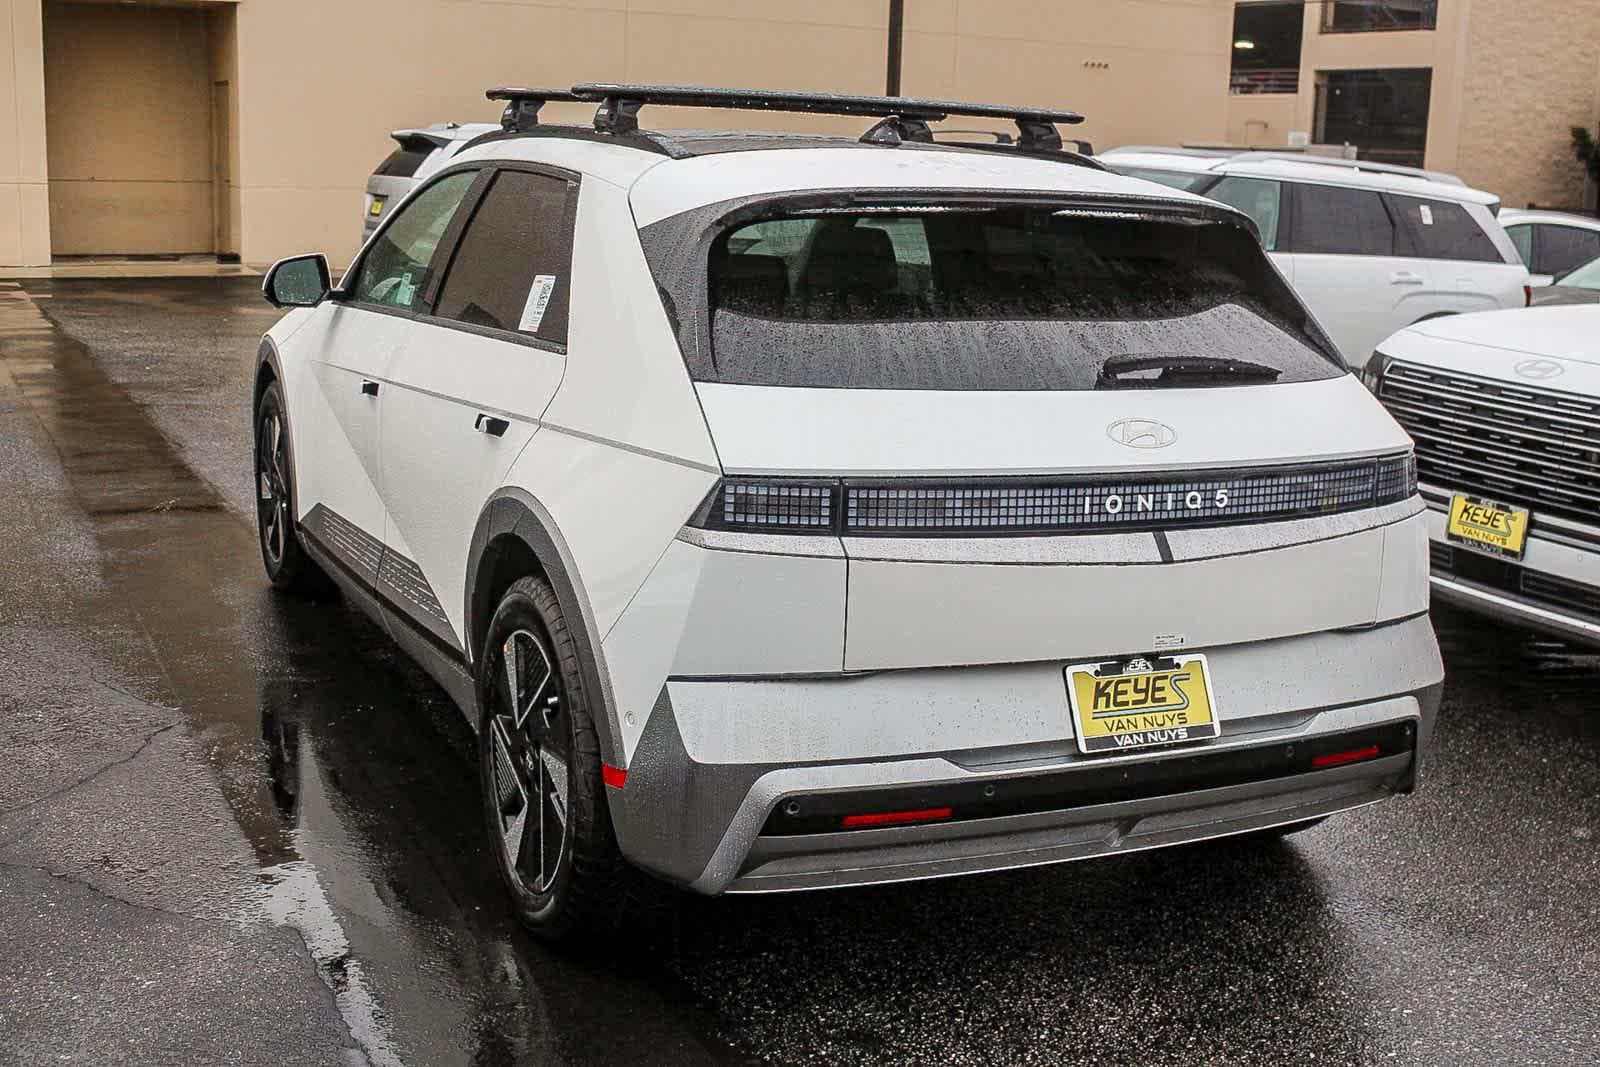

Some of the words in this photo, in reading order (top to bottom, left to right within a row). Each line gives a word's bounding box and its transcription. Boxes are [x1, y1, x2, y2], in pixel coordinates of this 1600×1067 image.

[1084, 491, 1202, 514] IONIQ
[1215, 489, 1228, 508] 5
[1459, 504, 1516, 533] KEYES
[1462, 526, 1480, 539] VAN
[1482, 533, 1508, 546] NUYS
[1092, 672, 1191, 713] KEYES
[1104, 718, 1138, 732] VAN
[1143, 712, 1188, 728] NUYS
[1113, 733, 1142, 747] VAN
[1147, 728, 1188, 743] NUYS
